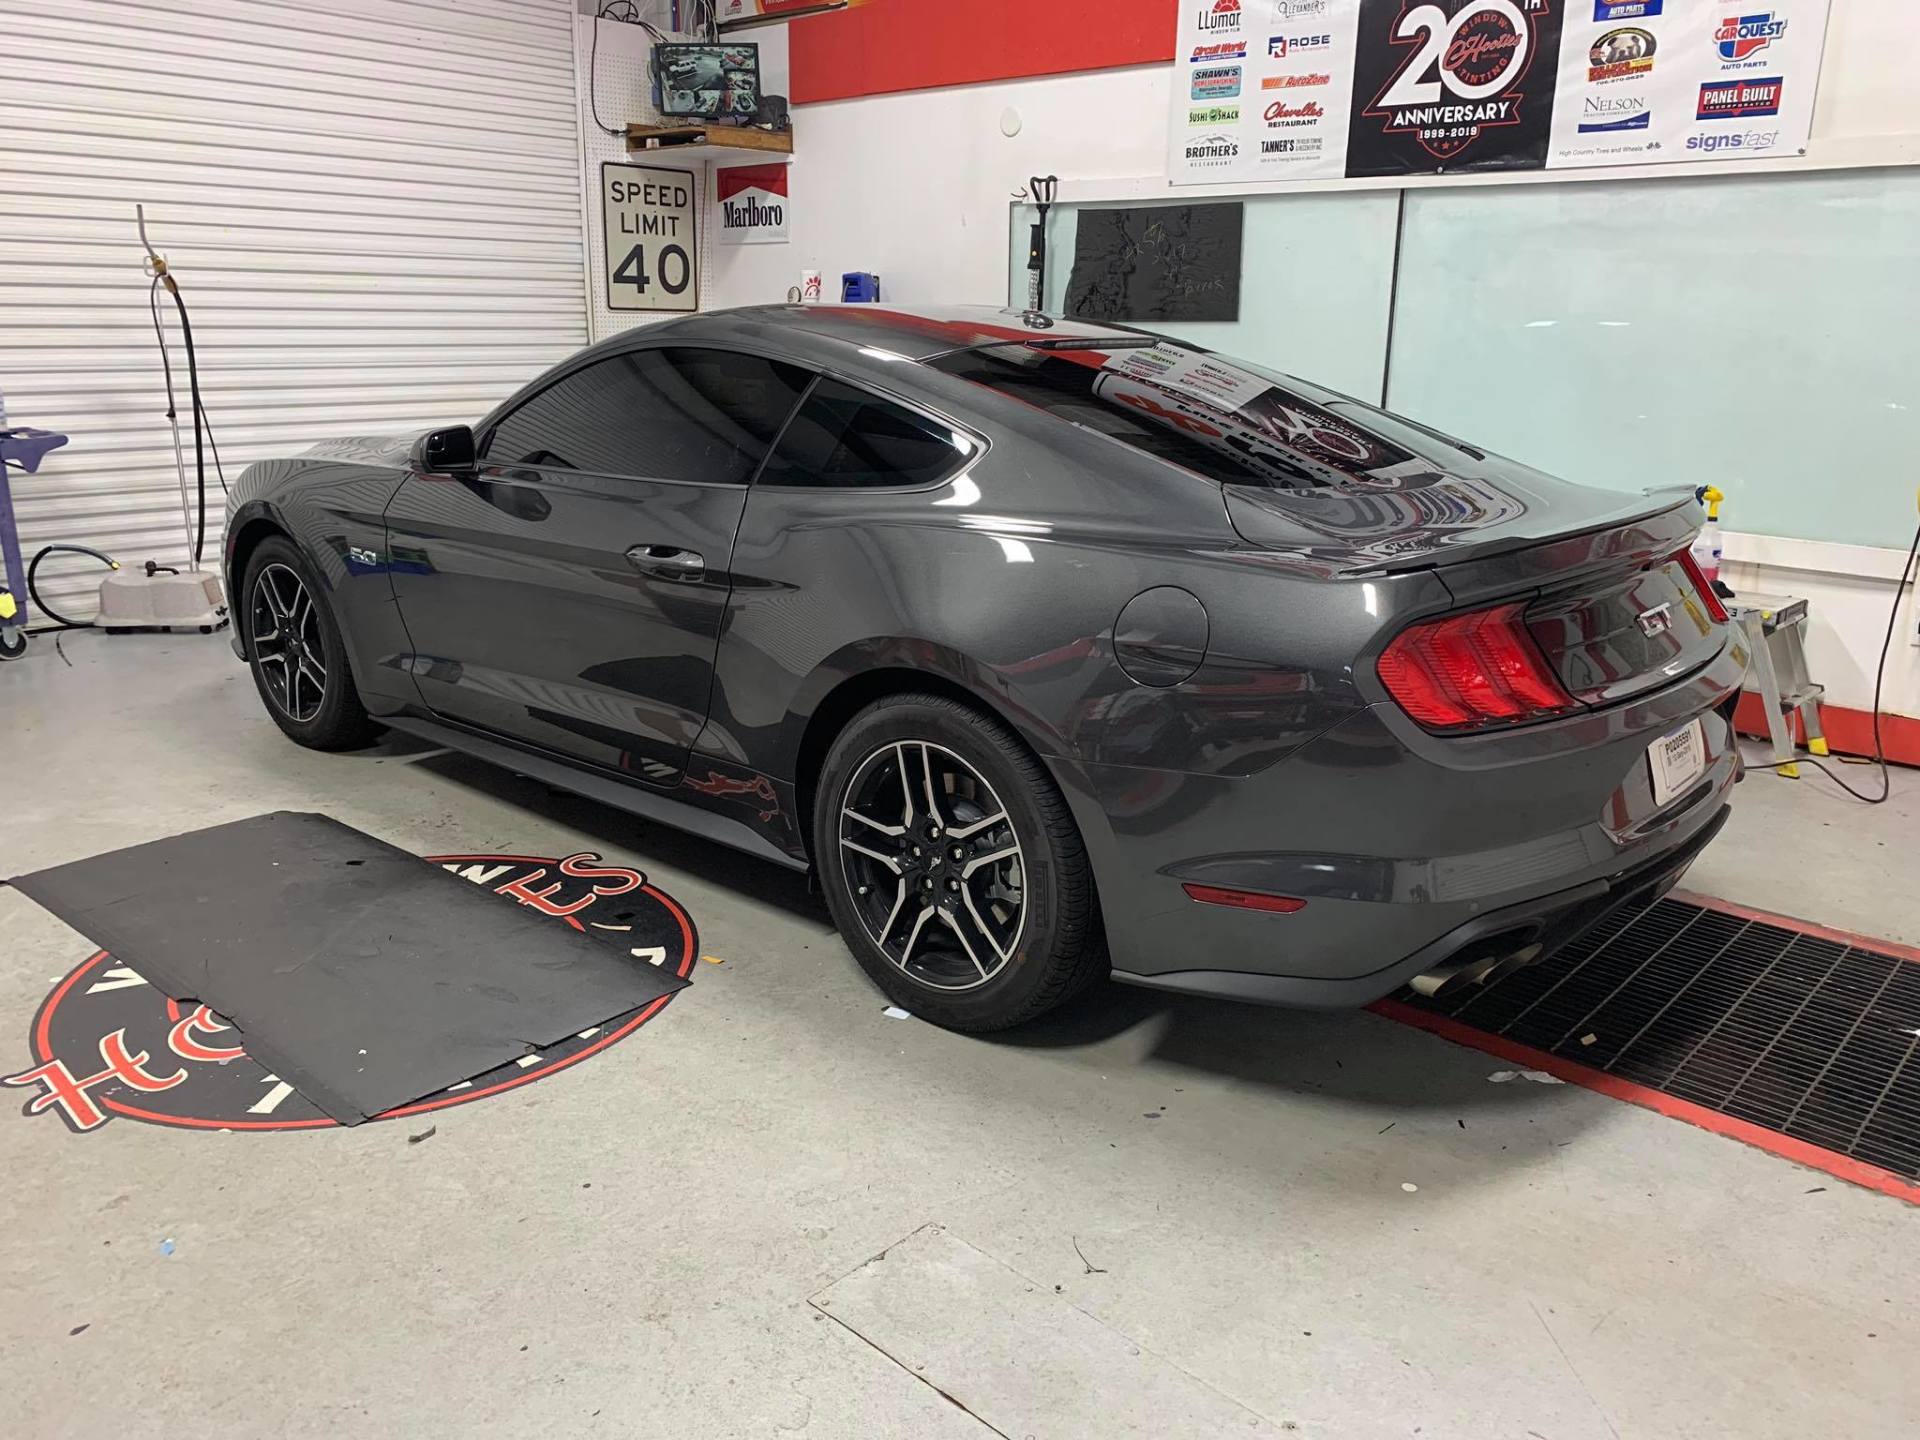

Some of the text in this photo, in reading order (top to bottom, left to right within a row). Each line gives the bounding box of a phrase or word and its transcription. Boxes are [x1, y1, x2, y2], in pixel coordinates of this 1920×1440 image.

[1198, 10, 1241, 30] LLumar
[1715, 21, 1783, 40] CARQUEST
[1289, 35, 1331, 47] ROSE
[1377, 0, 1528, 107] 20
[1195, 68, 1239, 80] SHAWN'S
[1721, 62, 1741, 70] AUTO
[1704, 86, 1777, 104] PANEL BUILT
[1393, 101, 1510, 126] ANNIVERSARY
[1585, 97, 1644, 112] NELSON
[1189, 110, 1240, 122] SUSHI SHACK
[1268, 119, 1318, 128] RESTAURANT
[1420, 127, 1478, 139] 1999-2019
[1687, 130, 1780, 151] signsfast
[1186, 143, 1239, 158] BROTHER'S
[1261, 139, 1295, 153] TANNER'S
[611, 180, 687, 208] SPEED
[723, 196, 782, 228] Marlboro
[621, 212, 679, 236] LIMIT
[613, 244, 690, 295] 40
[1637, 602, 1673, 637] GT
